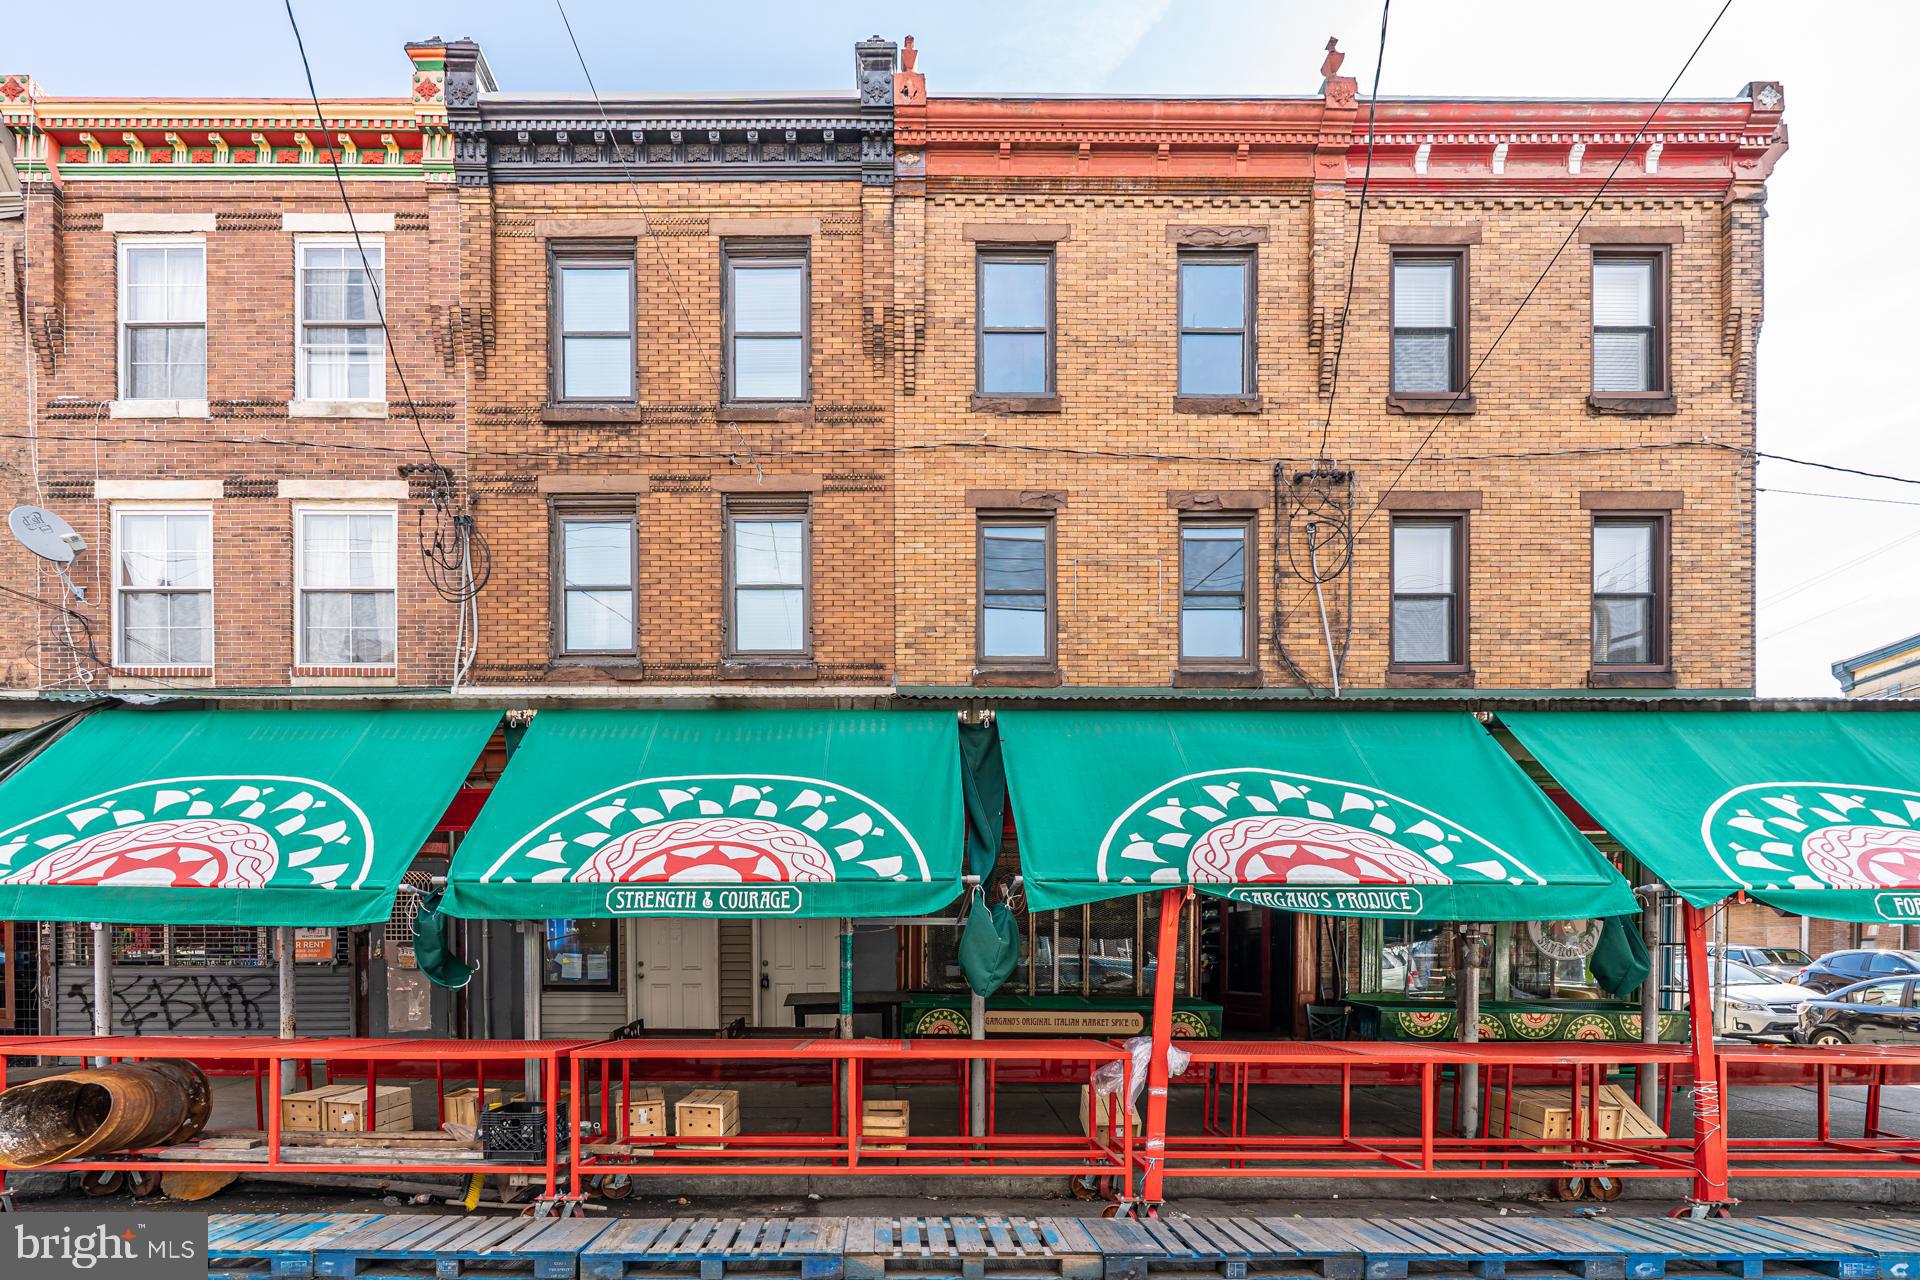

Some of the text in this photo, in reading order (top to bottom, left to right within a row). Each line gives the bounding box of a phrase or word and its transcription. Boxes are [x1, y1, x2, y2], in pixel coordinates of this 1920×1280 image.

[615, 891, 790, 909] STRENGTH & COURAGE
[1240, 892, 1412, 910] GARGANO'S PRODUCE
[1537, 936, 1557, 955] SAN
[985, 1016, 1020, 1026] GARGANO'S
[1021, 1017, 1051, 1026] ORIGINAL
[1054, 1018, 1080, 1027] ITALIAN
[1082, 1018, 1109, 1027] MARKET
[1111, 1018, 1129, 1027] SPICE
